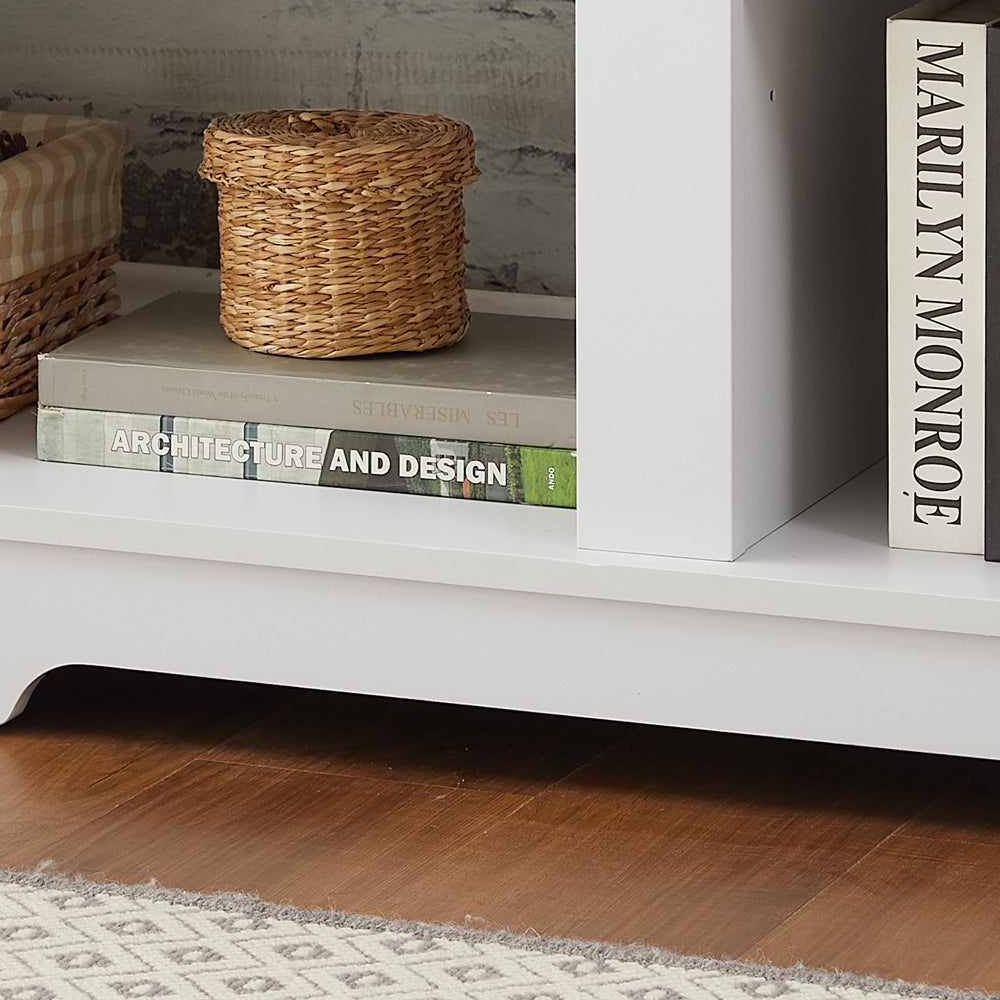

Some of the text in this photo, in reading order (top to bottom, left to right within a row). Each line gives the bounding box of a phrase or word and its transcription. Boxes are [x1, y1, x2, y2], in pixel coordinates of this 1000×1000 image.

[915, 38, 965, 285] MARILYN
[352, 399, 521, 427] LES MISERABLES
[111, 429, 507, 486] ARCHITECTURE AND DESIGN
[548, 467, 556, 491] ANDO
